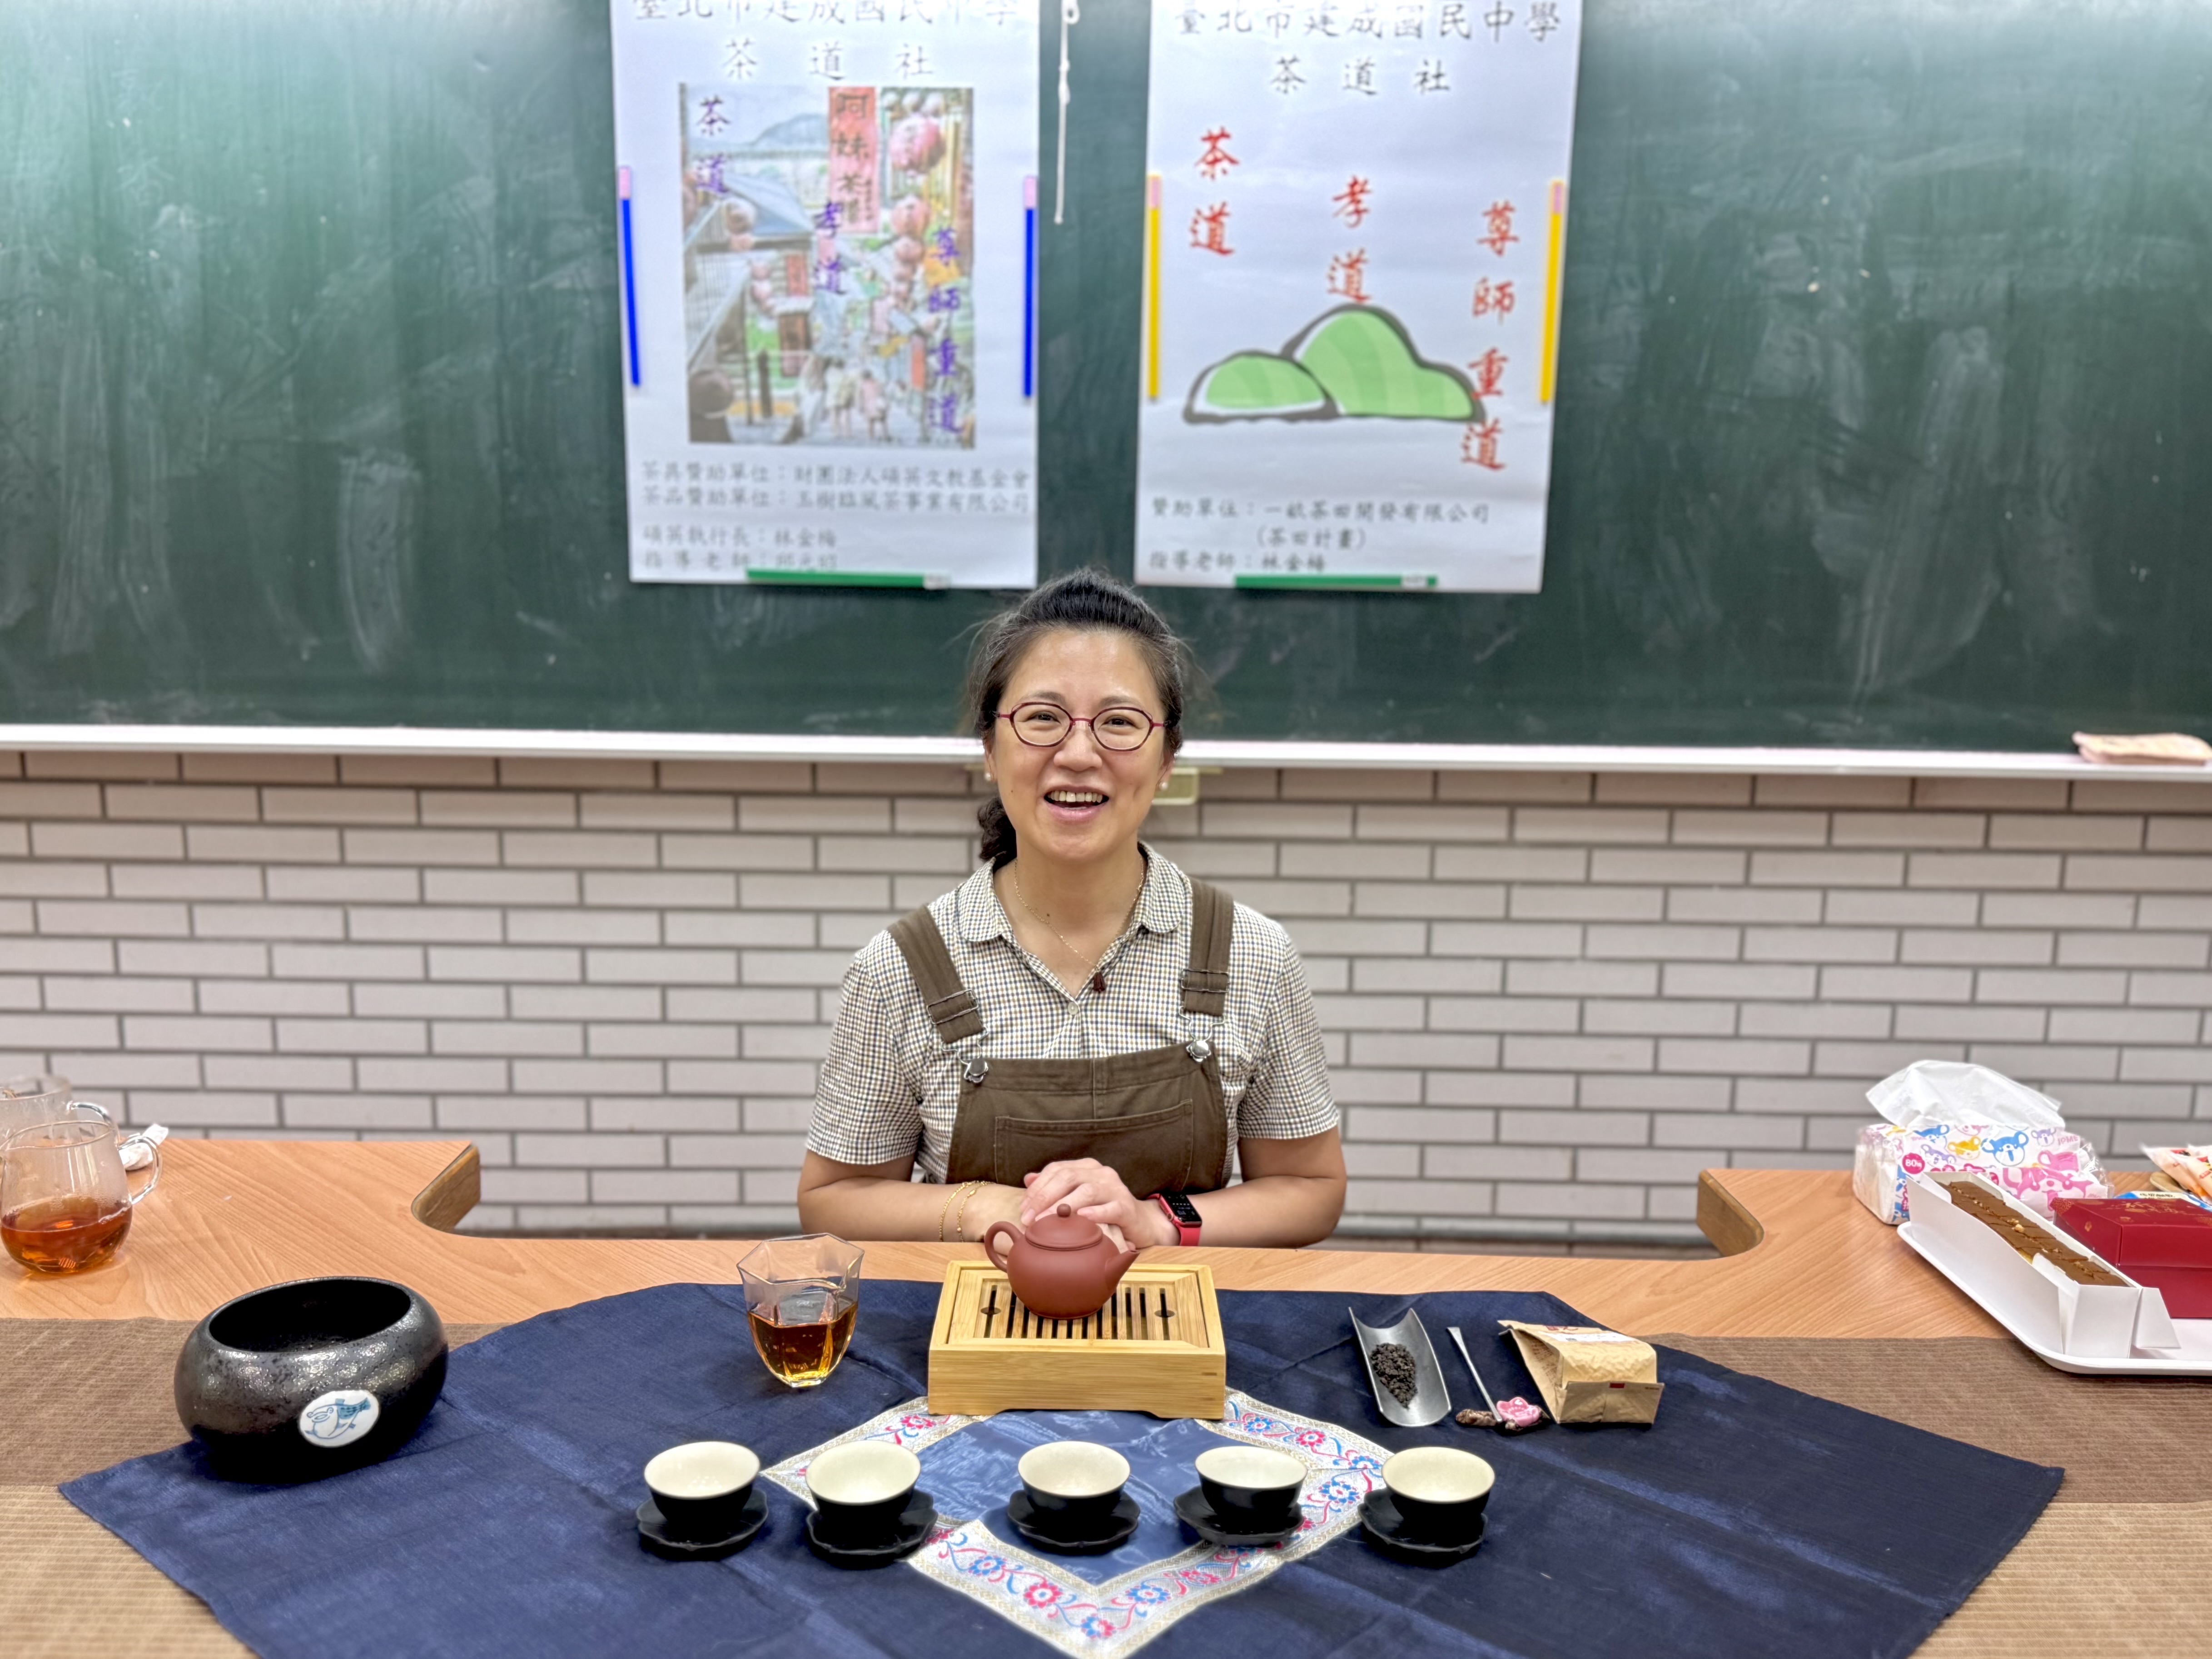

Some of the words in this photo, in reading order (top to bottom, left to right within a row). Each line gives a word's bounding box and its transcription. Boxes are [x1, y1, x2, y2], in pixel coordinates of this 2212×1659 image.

[722, 38, 934, 80] 茶道社
[1271, 55, 1450, 95] 茶道社
[696, 94, 731, 194] 茶道
[1189, 126, 1239, 256] 茶道
[814, 200, 847, 294] 孝道
[1327, 175, 1372, 303] 孝道
[928, 225, 963, 433] 尊師重道
[1459, 200, 1520, 471] 尊師重道
